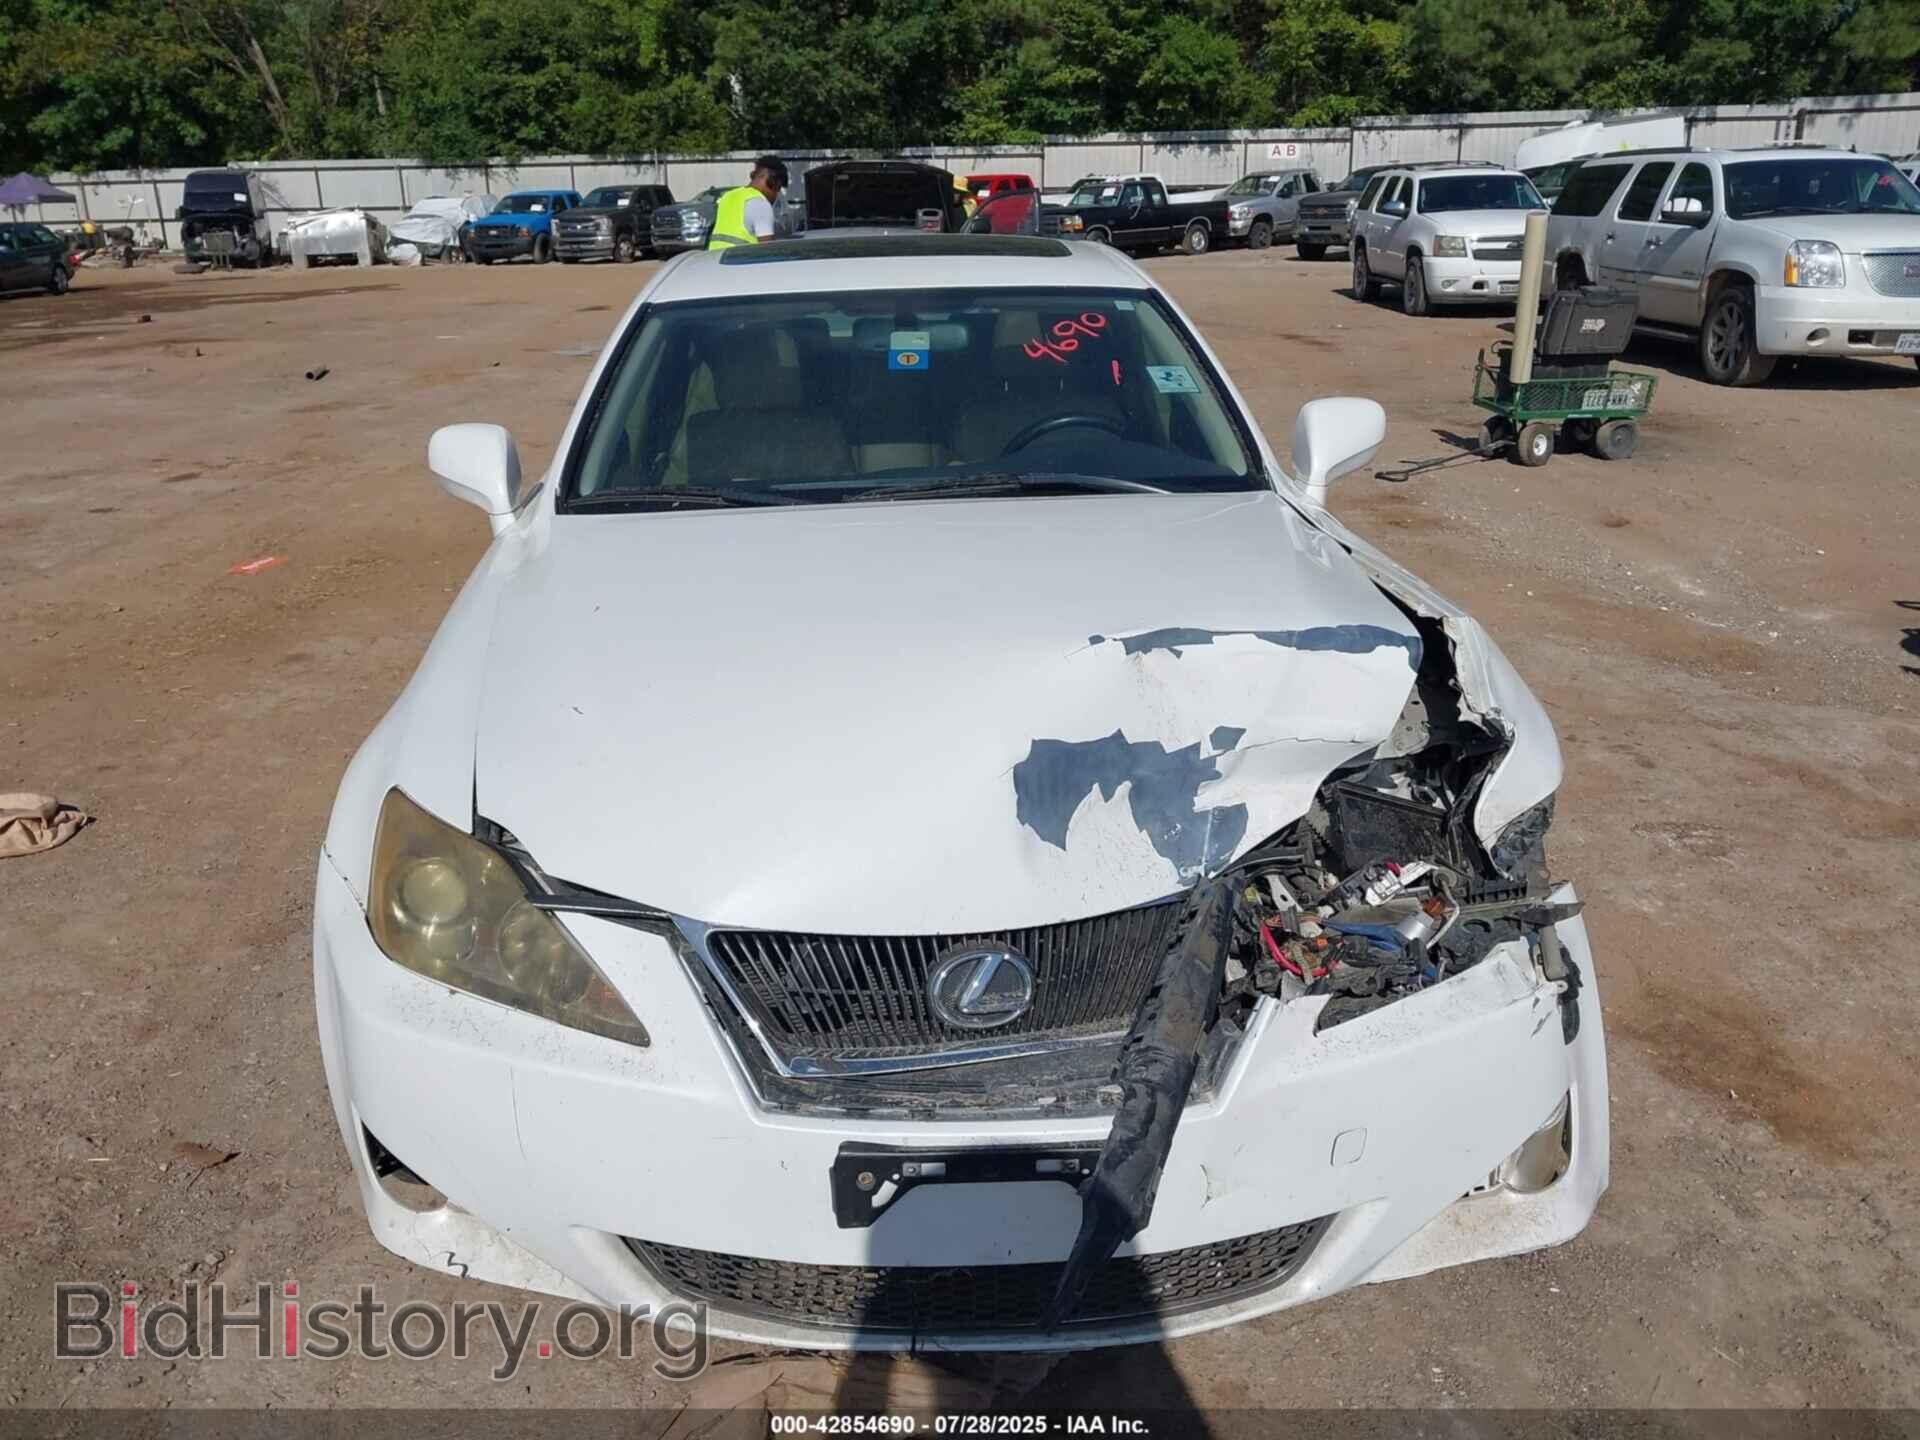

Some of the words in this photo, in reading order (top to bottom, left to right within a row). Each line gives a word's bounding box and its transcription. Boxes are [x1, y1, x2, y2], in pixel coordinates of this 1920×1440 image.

[1272, 144, 1281, 156] A
[1286, 144, 1297, 156] B
[1023, 312, 1106, 364] 4690
